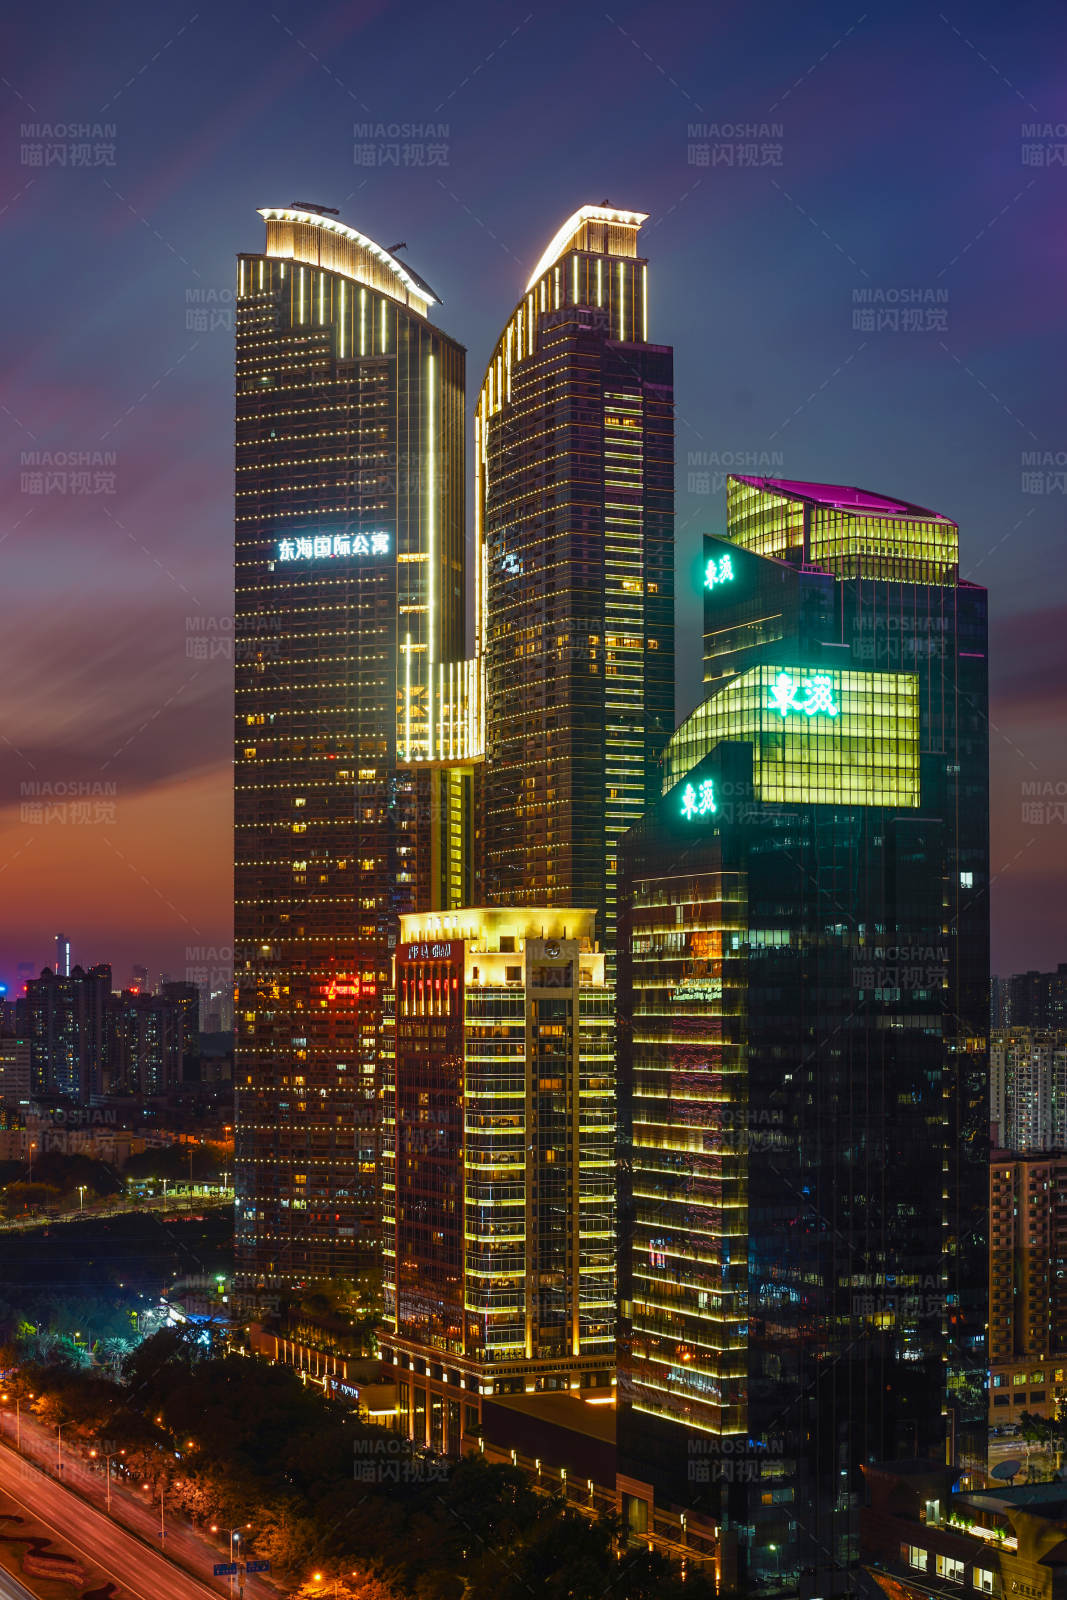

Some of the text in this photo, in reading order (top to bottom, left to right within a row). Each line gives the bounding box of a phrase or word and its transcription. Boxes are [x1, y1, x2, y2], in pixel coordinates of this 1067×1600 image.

[278, 534, 389, 560] 东海国际公寓
